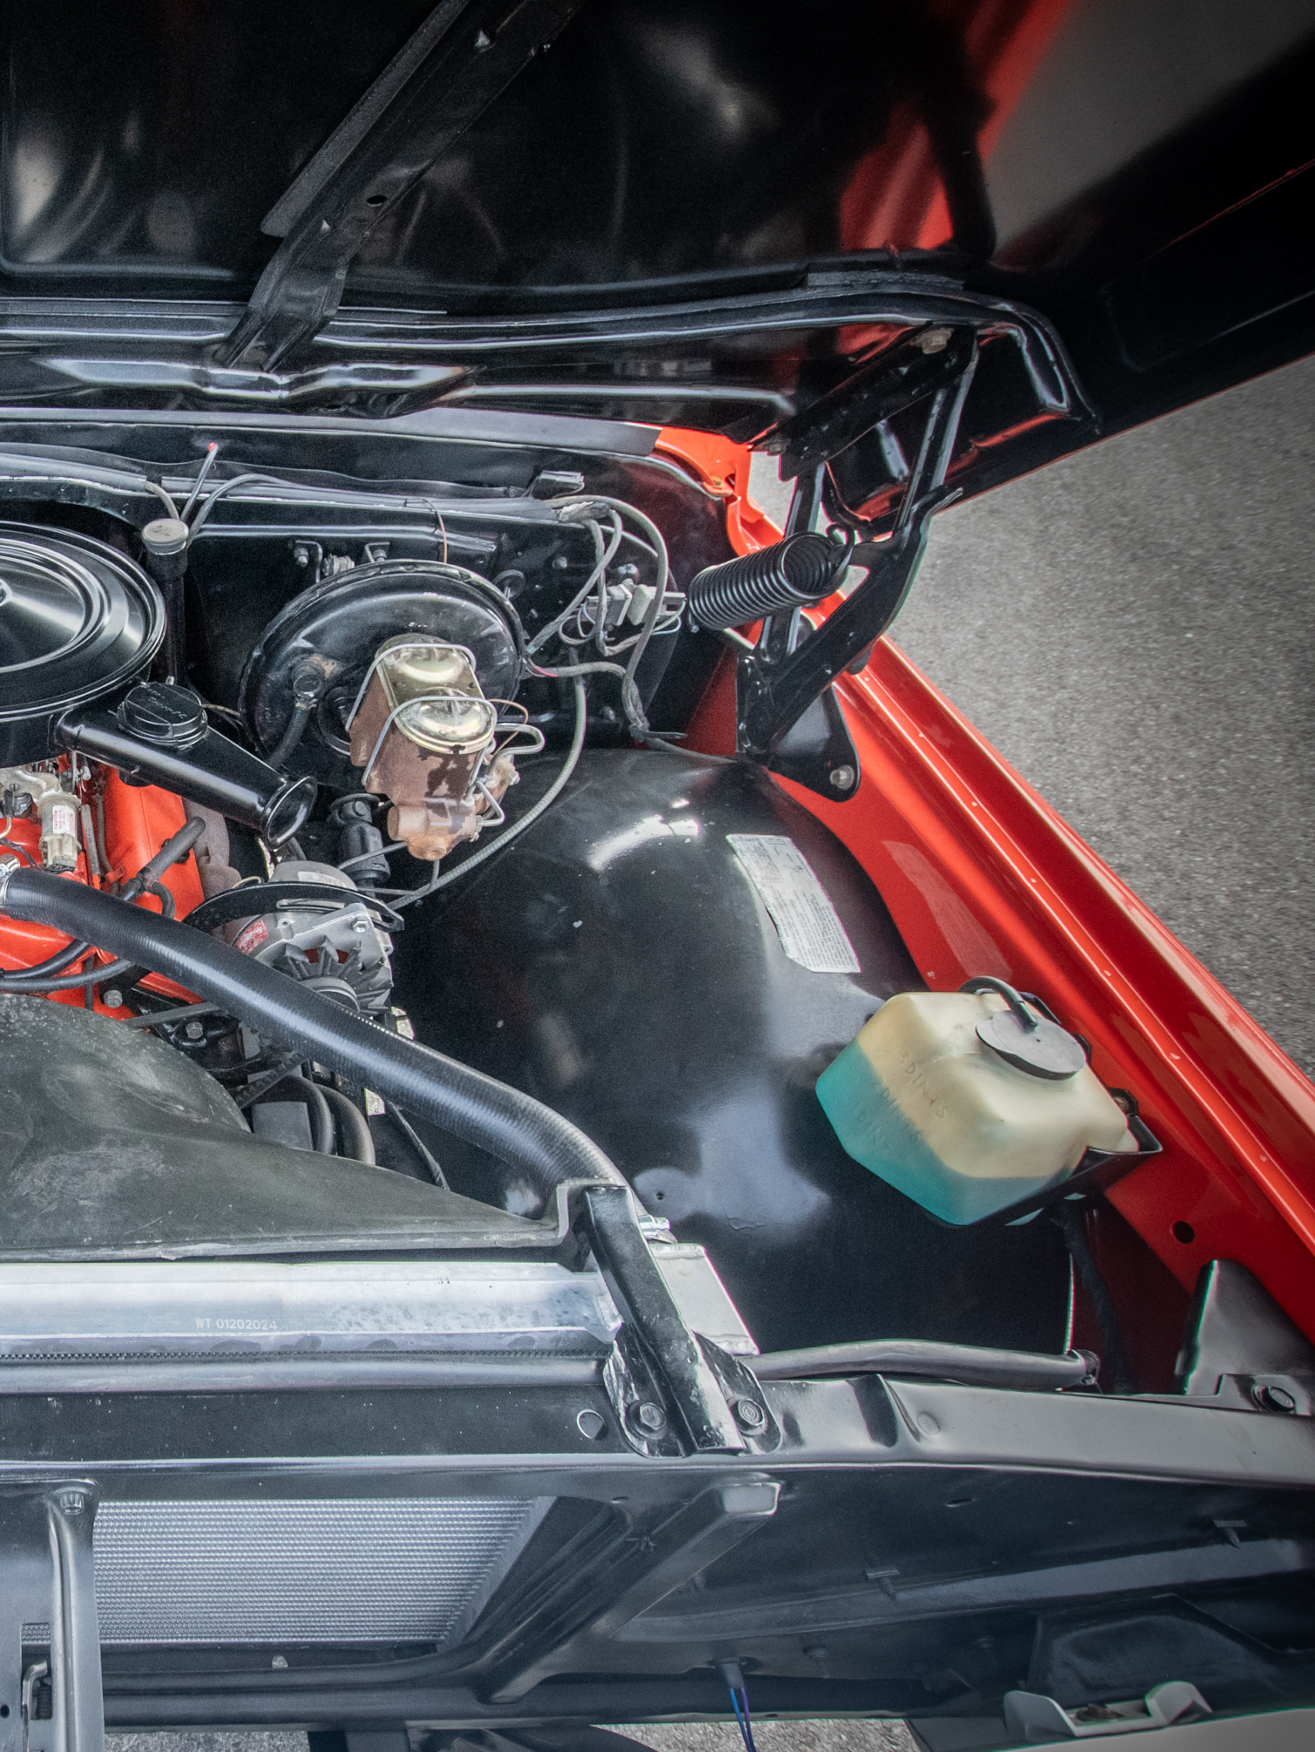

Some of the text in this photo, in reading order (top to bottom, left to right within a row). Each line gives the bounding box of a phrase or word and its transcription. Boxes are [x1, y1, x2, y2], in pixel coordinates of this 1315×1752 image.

[153, 525, 171, 537] OIL
[898, 1050, 949, 1119] 3 PINTS
[195, 1318, 277, 1330] WT 01202024
